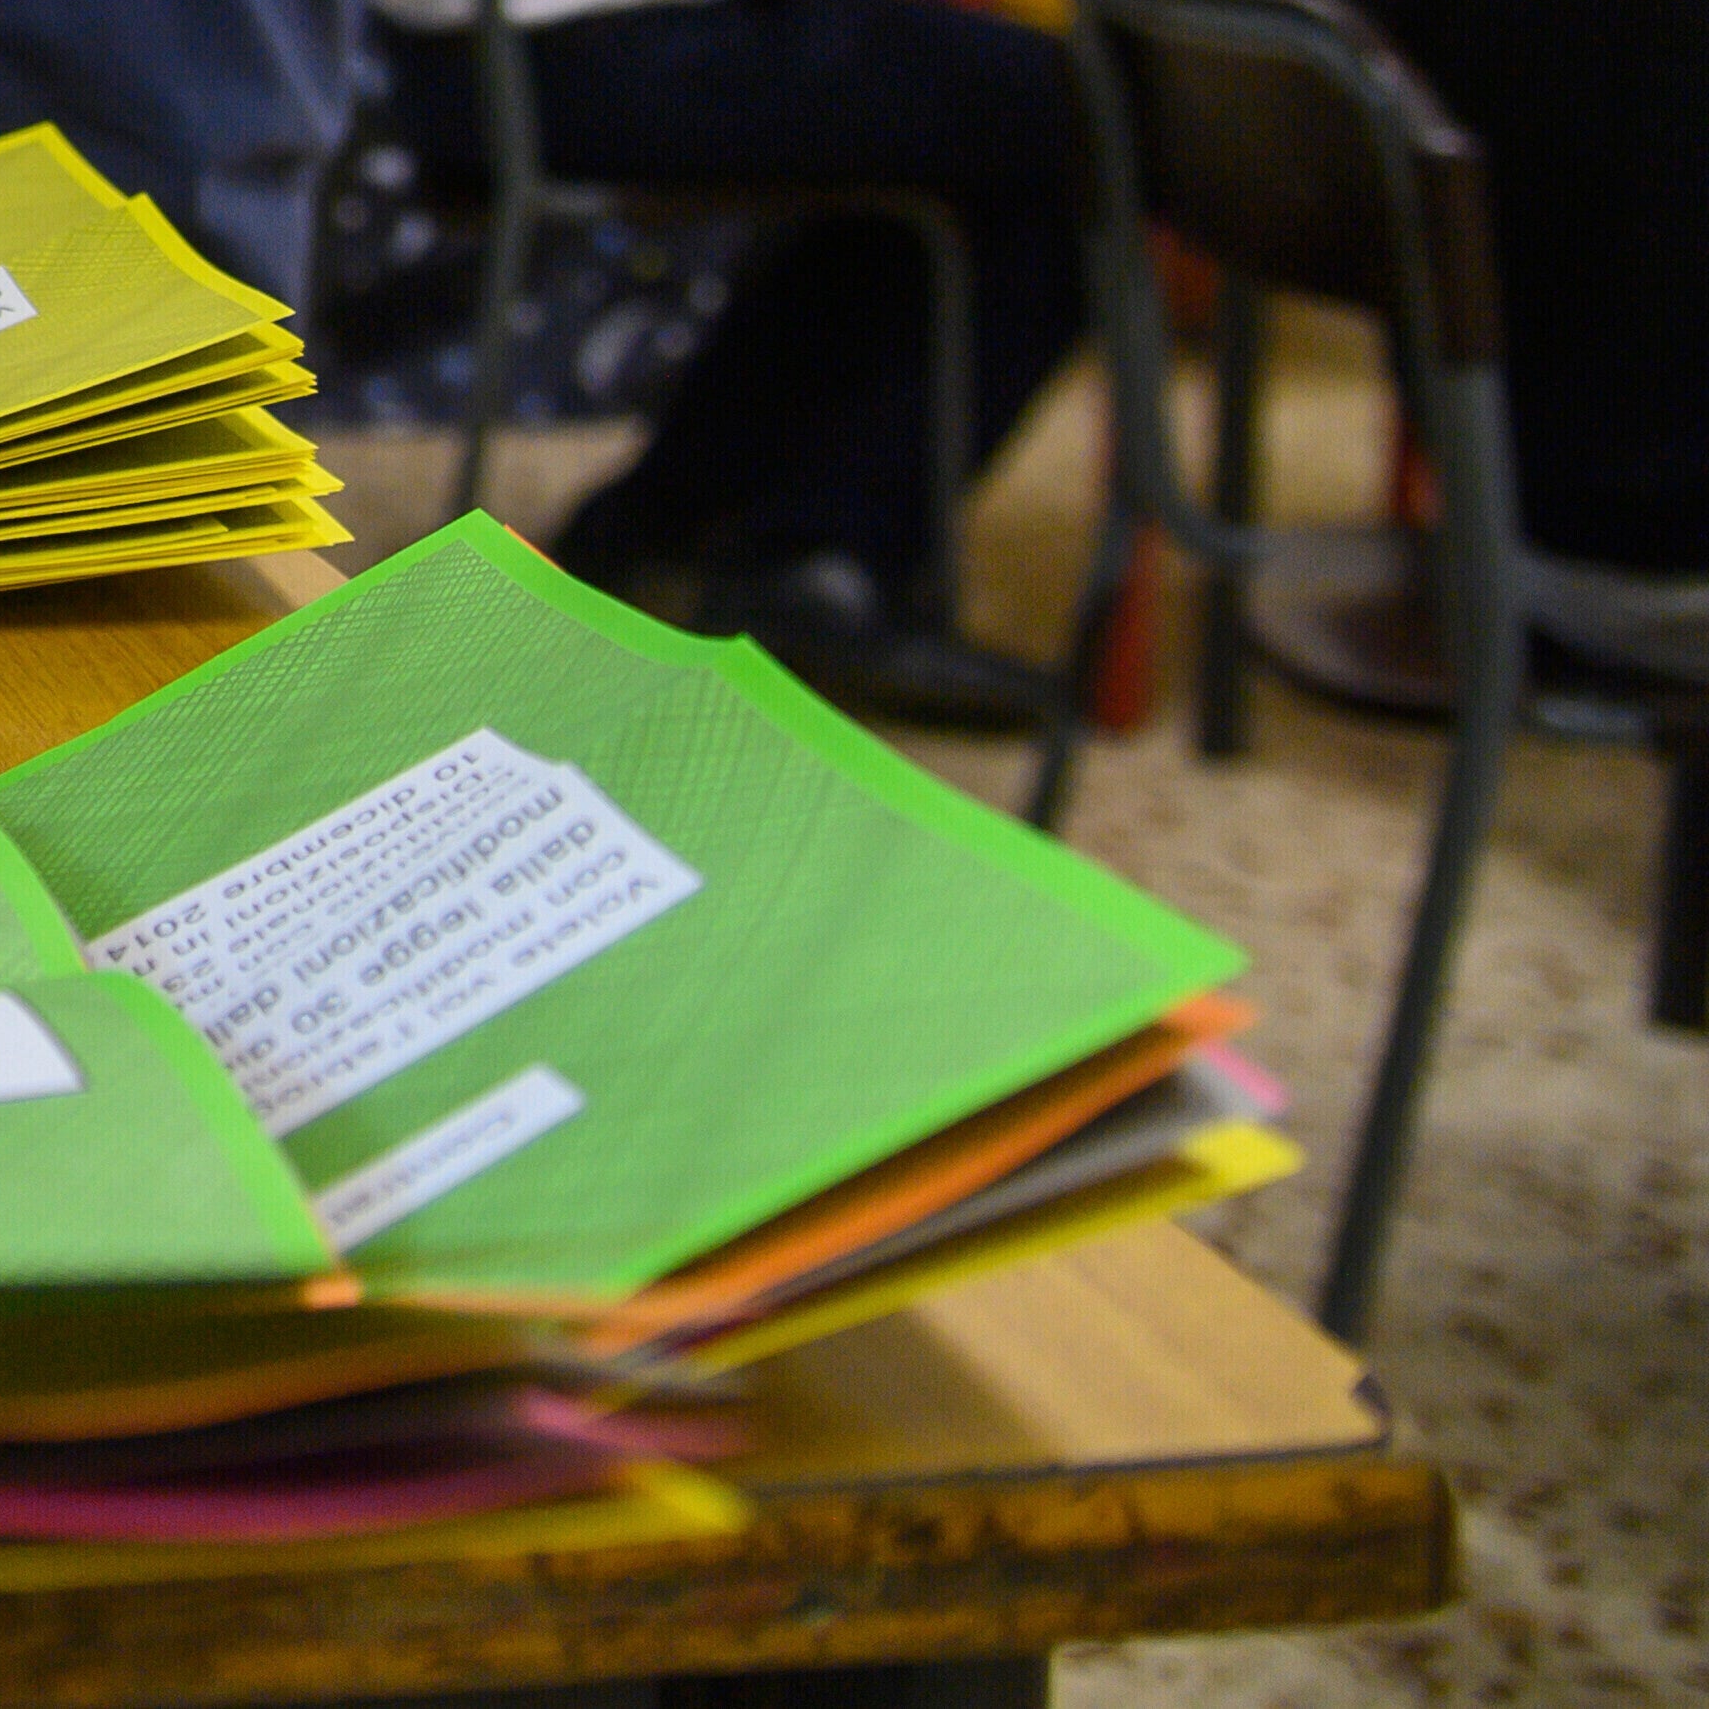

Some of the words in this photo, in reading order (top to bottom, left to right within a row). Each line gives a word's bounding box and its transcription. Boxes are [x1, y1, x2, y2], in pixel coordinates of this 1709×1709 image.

[434, 749, 481, 783] 10
[221, 786, 416, 901] dicembre
[490, 820, 595, 897] dalla
[292, 786, 564, 983] modificazioni
[546, 848, 626, 906] con
[170, 929, 212, 957] in
[359, 897, 485, 987] legge
[511, 877, 657, 966] Volete
[204, 985, 281, 1048] dall
[290, 991, 349, 1035] 30
[427, 973, 497, 1020] voi
